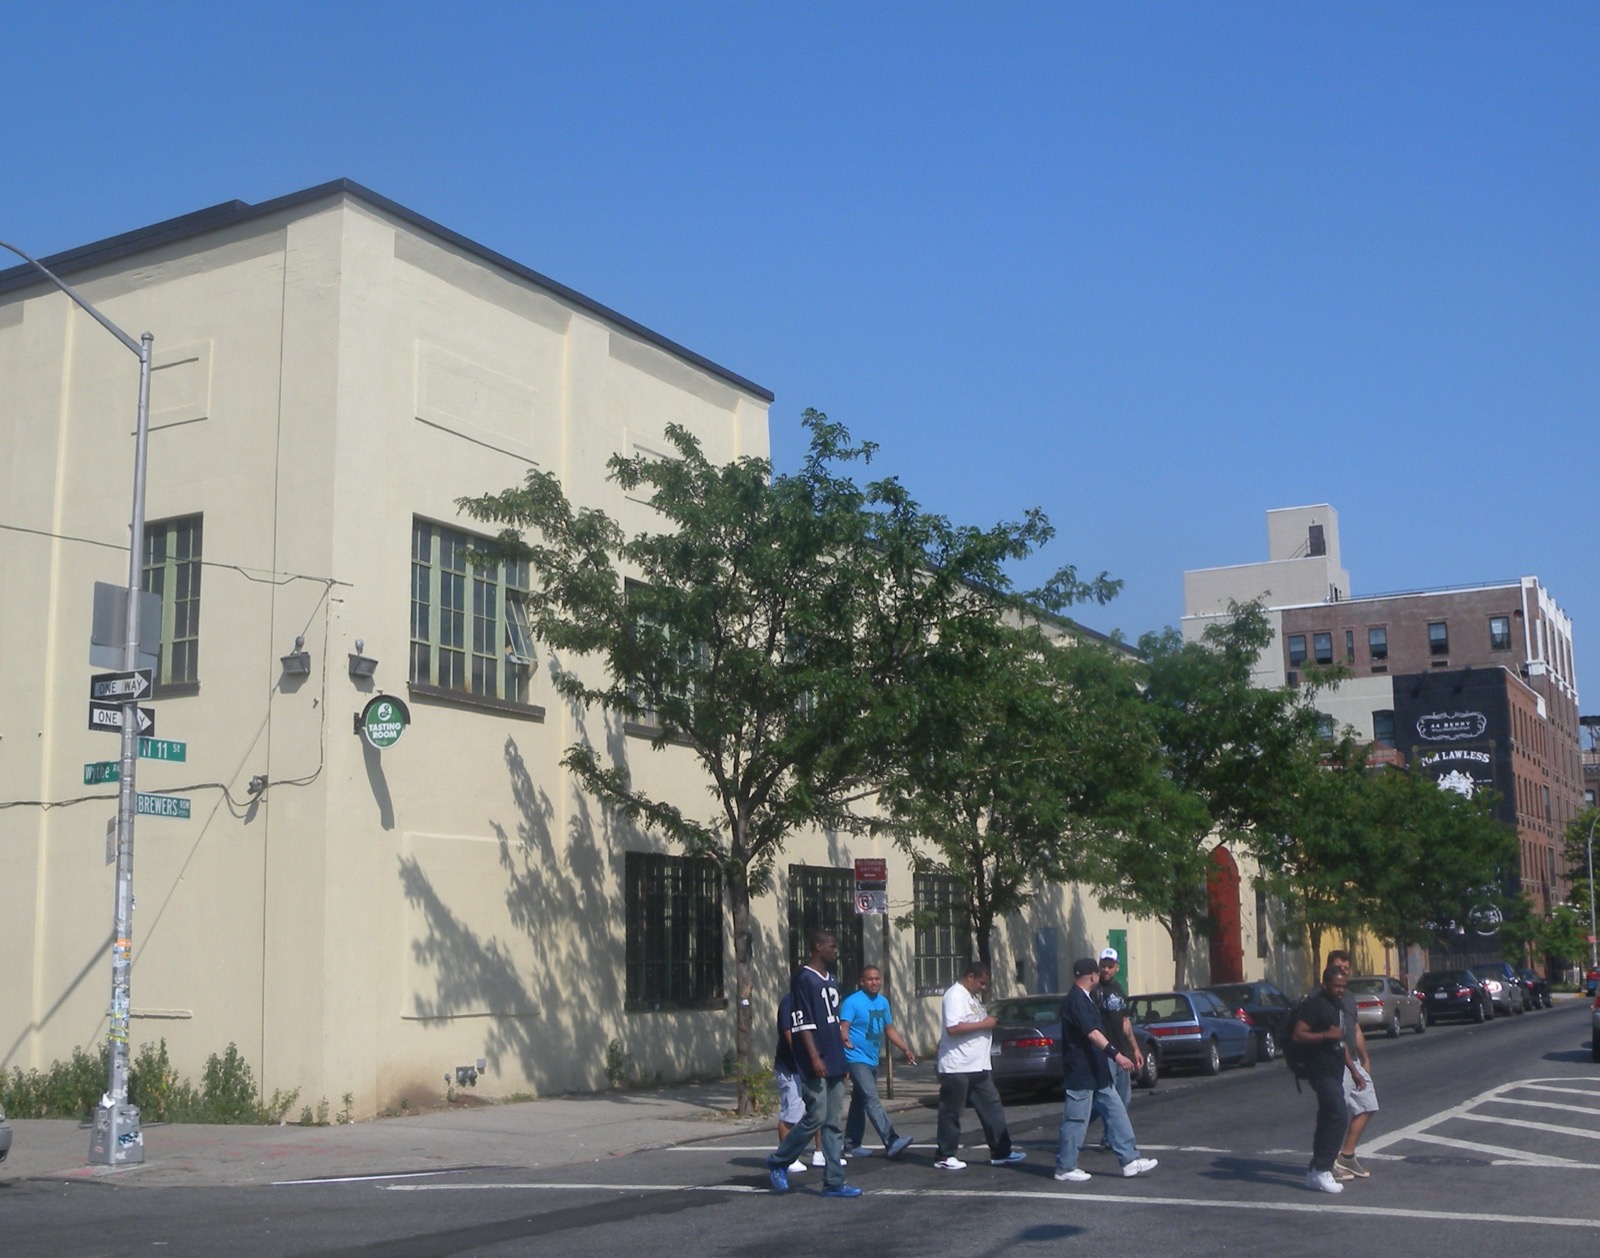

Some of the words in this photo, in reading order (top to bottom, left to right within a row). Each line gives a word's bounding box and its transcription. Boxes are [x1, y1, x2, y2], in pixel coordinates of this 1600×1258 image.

[99, 682, 116, 697] ONE
[124, 679, 143, 692] WAY
[98, 710, 118, 725] ONE
[368, 722, 401, 732] TASTING
[372, 731, 397, 739] ROOM
[143, 741, 152, 757] N
[157, 742, 168, 759] 11
[173, 743, 181, 753] St
[1442, 750, 1490, 763] LAWLESS
[138, 796, 178, 816] BREWERS
[791, 1010, 804, 1026] 12
